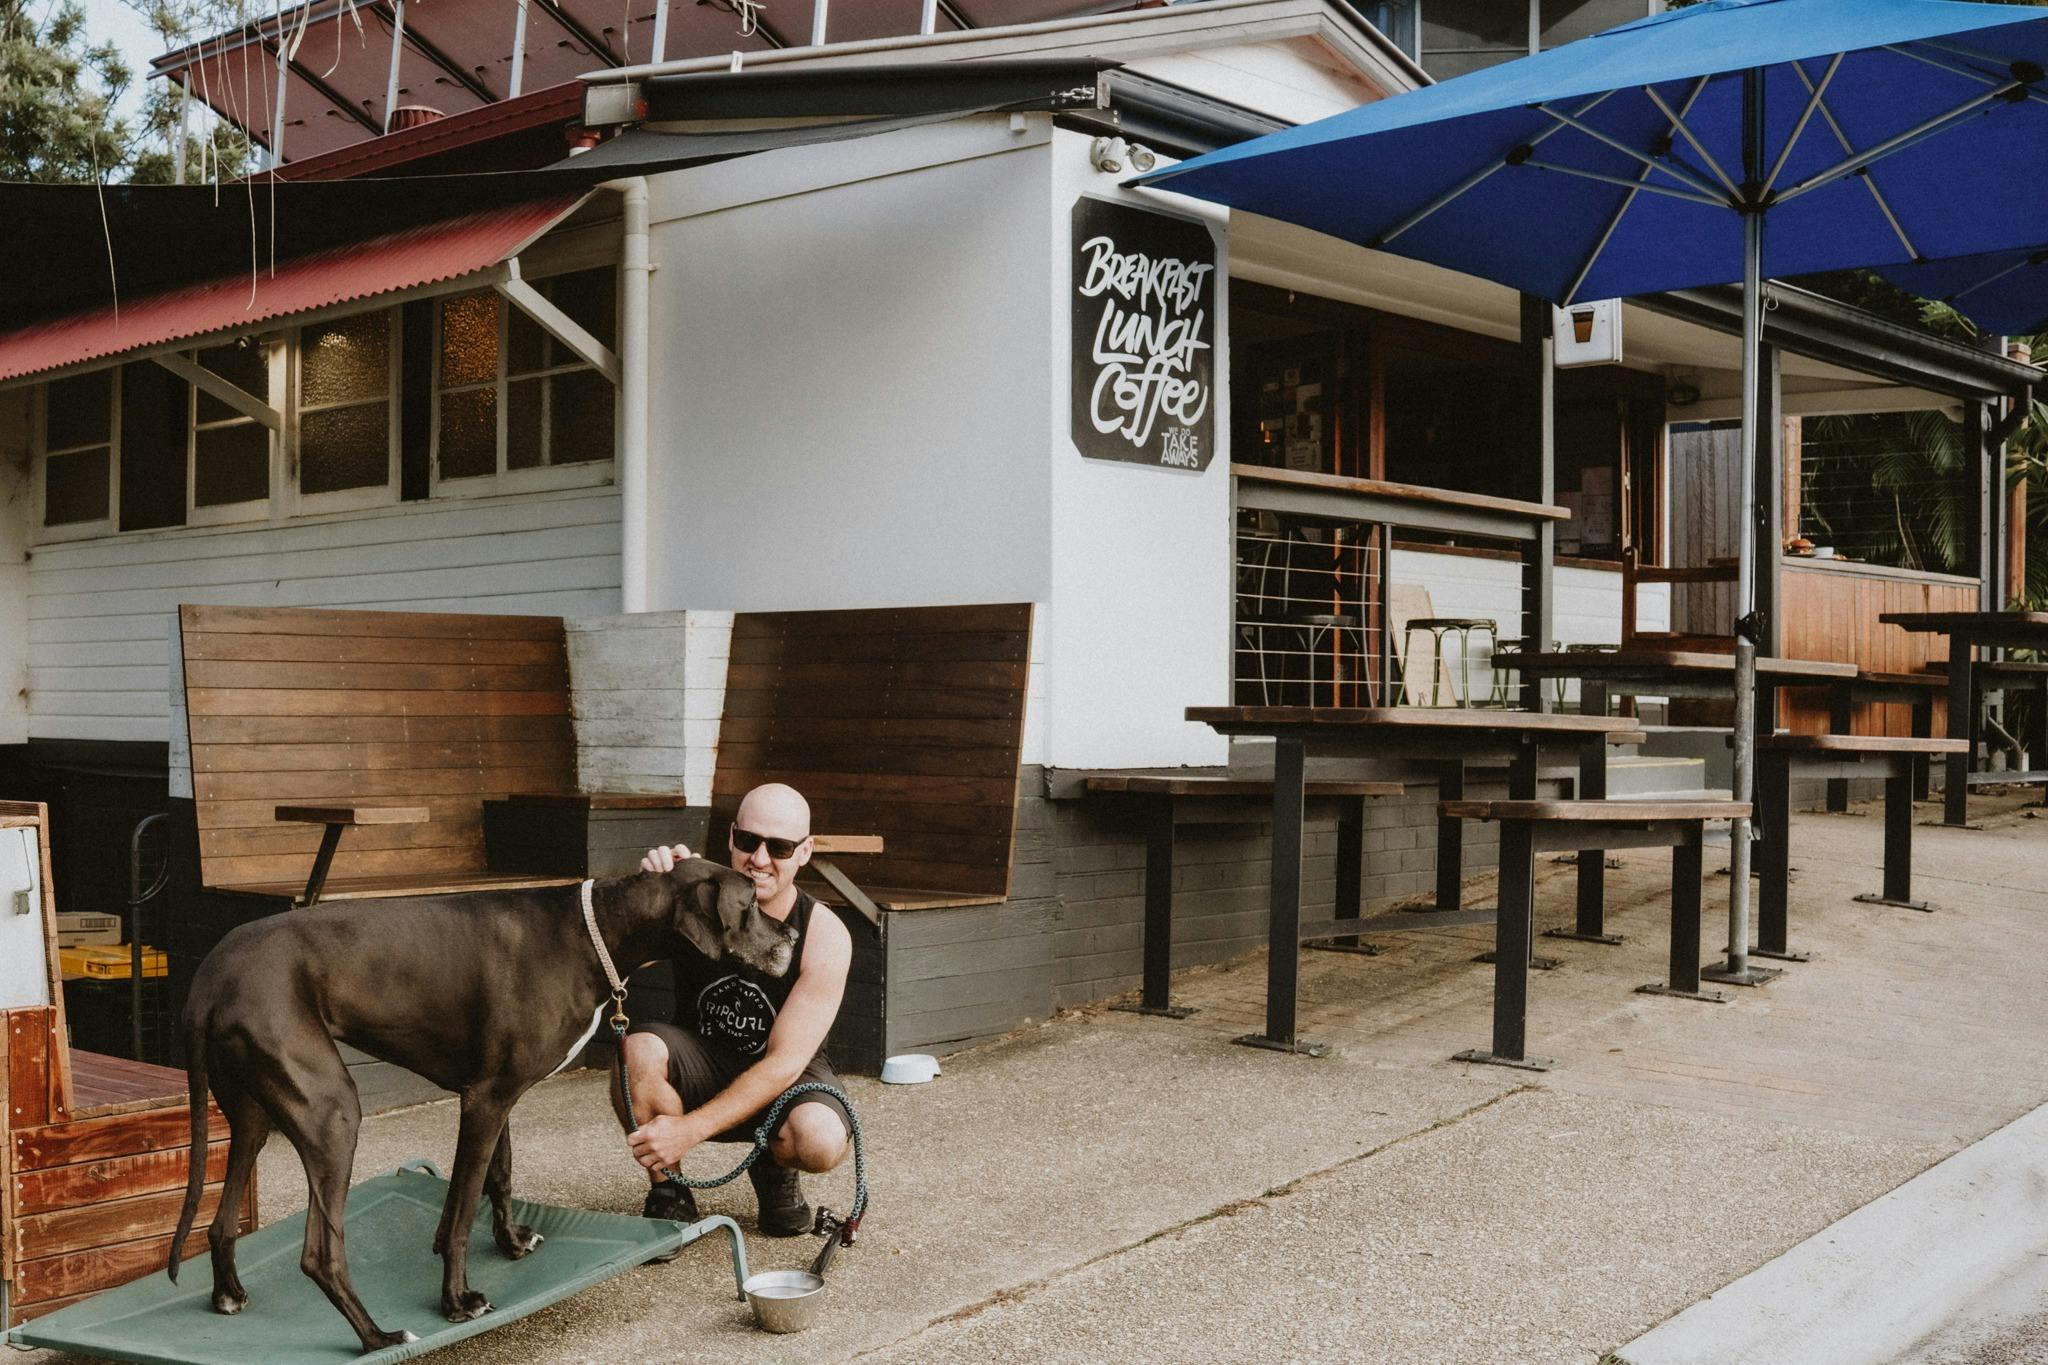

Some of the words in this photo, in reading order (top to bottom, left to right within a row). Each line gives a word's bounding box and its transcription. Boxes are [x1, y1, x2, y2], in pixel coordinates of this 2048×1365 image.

[1079, 236, 1214, 315] BREAKFAST
[1092, 298, 1211, 372] LUNCH
[1091, 355, 1208, 447] Coffee
[1161, 432, 1198, 451] TAKE
[1168, 426, 1179, 435] WE
[1181, 427, 1191, 436] DO
[1161, 448, 1198, 468] AWAYS
